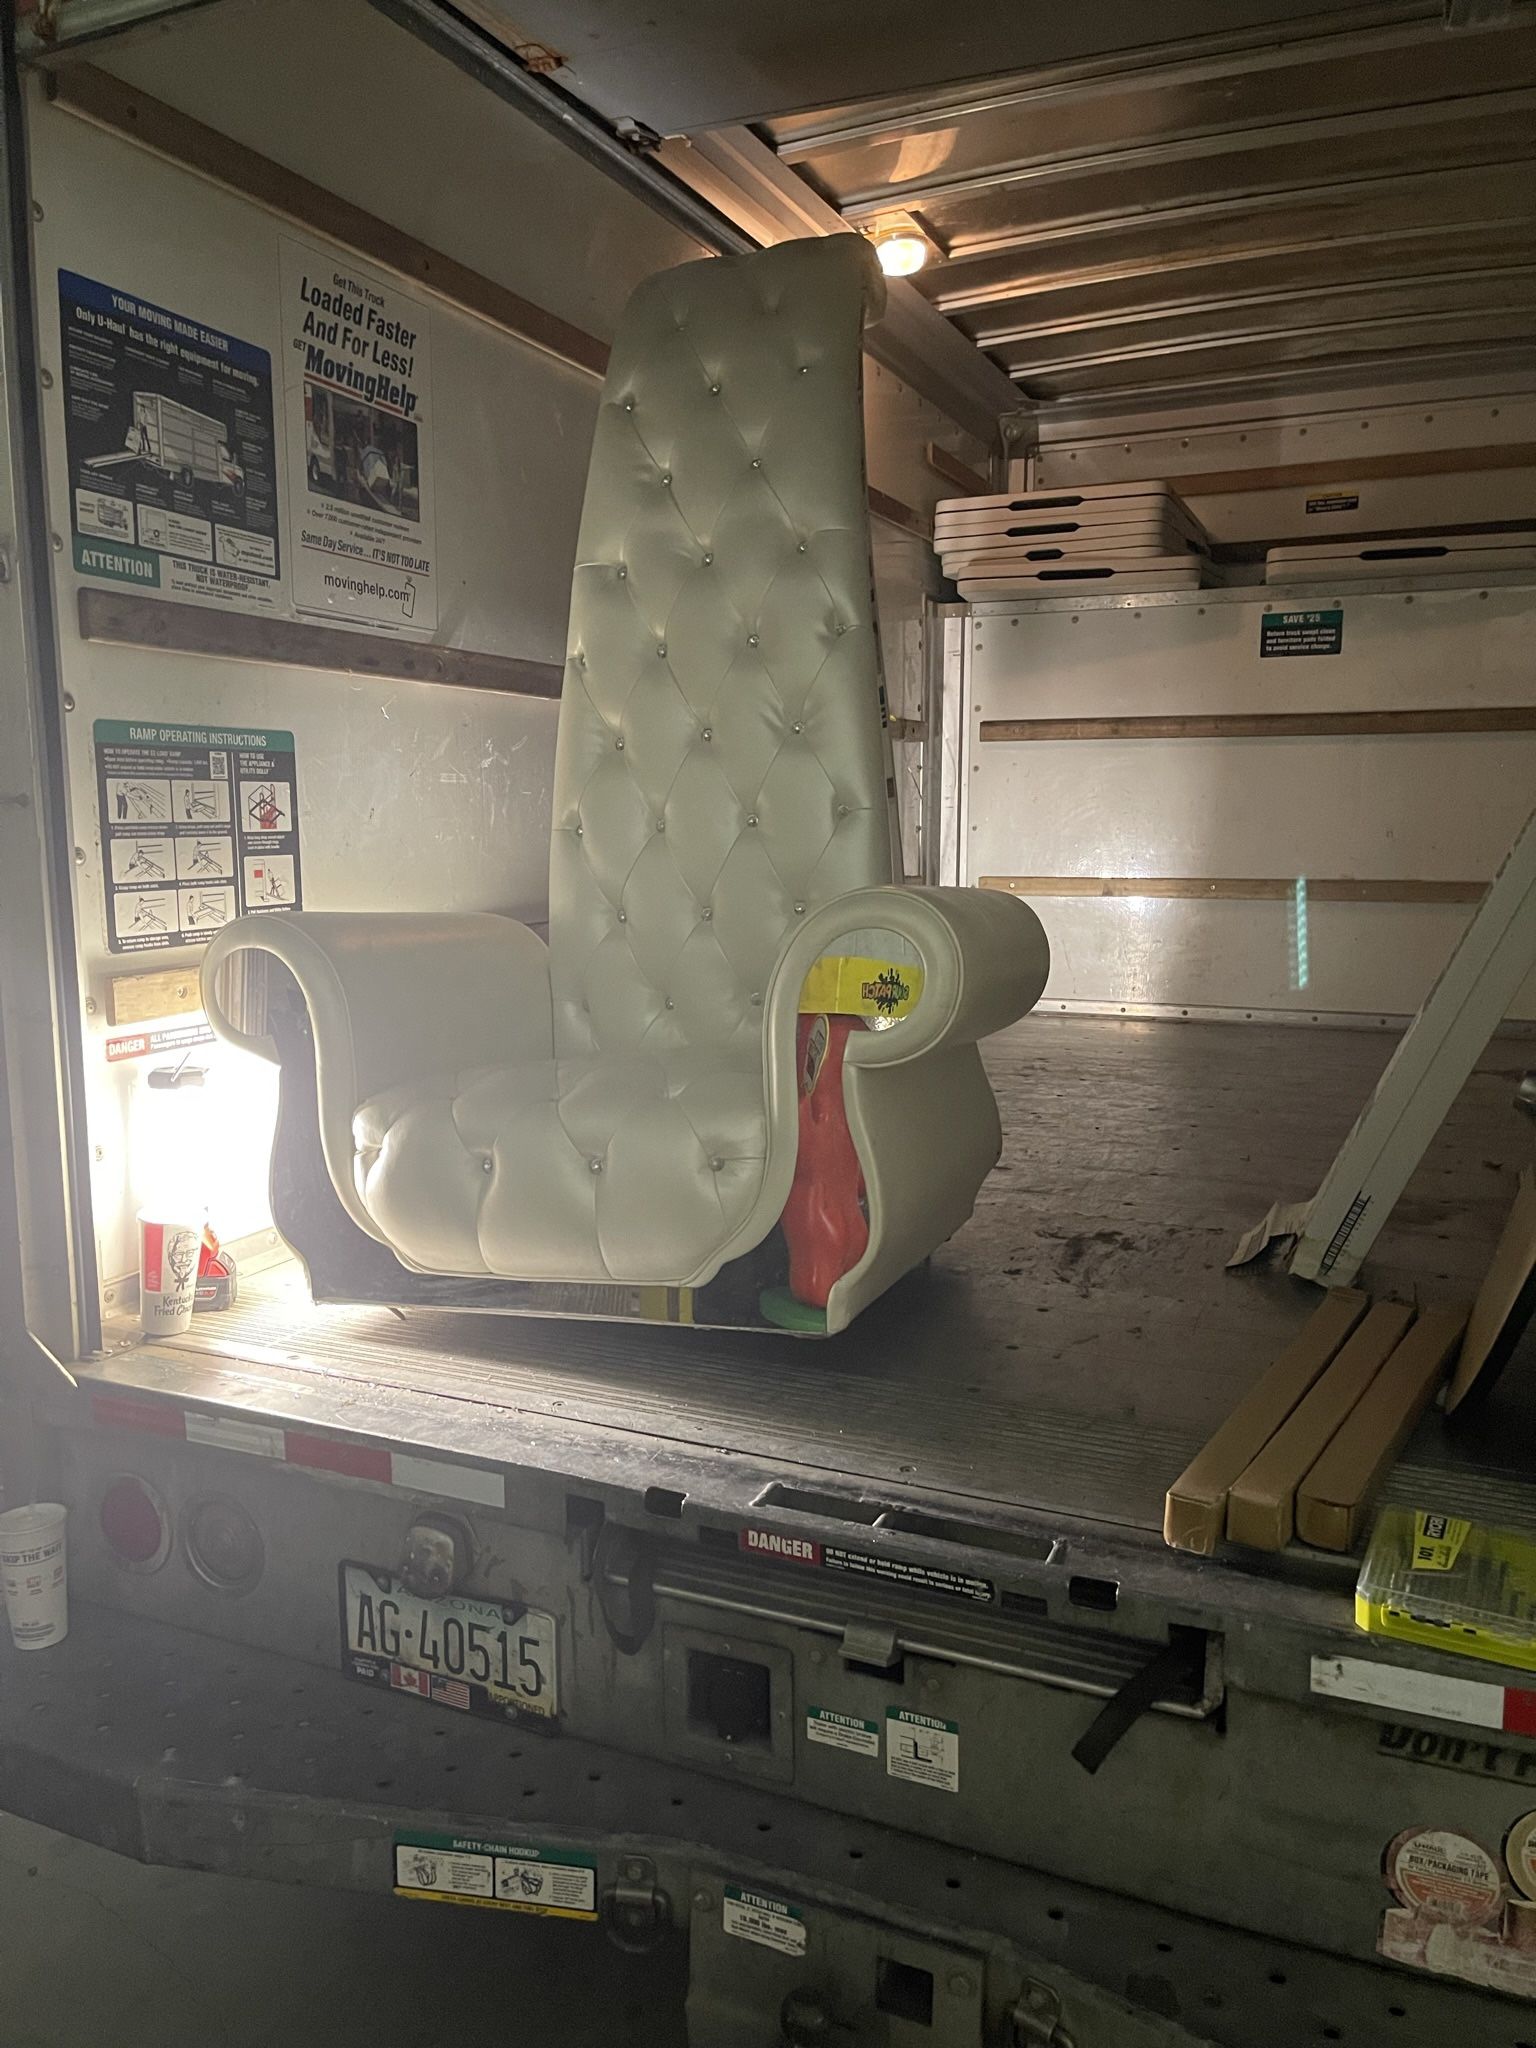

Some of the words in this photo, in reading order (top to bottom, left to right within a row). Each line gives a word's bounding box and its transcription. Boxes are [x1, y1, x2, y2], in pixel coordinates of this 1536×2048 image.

[333, 273, 346, 289] Get
[348, 280, 363, 298] This
[365, 288, 385, 308] Truck
[300, 276, 364, 327] Loaded
[366, 308, 417, 350] Faster
[112, 295, 136, 316] YOUR
[138, 304, 173, 329] MOVING
[174, 319, 199, 341] MADE
[200, 328, 229, 352] EASIER
[76, 307, 95, 327] Only
[129, 327, 144, 343] has
[145, 333, 159, 348] the
[160, 338, 179, 356] right
[180, 348, 220, 370] equipment
[220, 360, 231, 375] for
[293, 338, 307, 352] GET
[302, 311, 339, 346] And
[341, 327, 369, 358] For
[372, 340, 414, 379] Less!
[305, 344, 418, 418] MovingHelp
[301, 530, 322, 546] Same
[322, 535, 337, 552] Day
[372, 548, 386, 562] IT'S
[386, 552, 400, 566] NOT
[401, 556, 414, 569] TOO
[414, 559, 430, 572] LATE
[82, 548, 153, 578] ATTENTION
[172, 560, 187, 571] THIS
[188, 562, 209, 574] TRUCK
[210, 566, 216, 575] IS
[196, 574, 207, 584] NOT
[324, 574, 410, 602] movinghelp.com
[1282, 614, 1304, 624] SAVE
[130, 727, 157, 741] RAMP
[160, 729, 207, 744] OPERATING
[209, 732, 267, 747] INSTRUCTIONS
[108, 1039, 146, 1056] DANGER
[154, 1304, 175, 1316] Fried
[162, 1293, 193, 1307] Kentuck
[22, 1552, 40, 1563] THE
[44, 1542, 63, 1557] WAIT
[748, 1530, 813, 1560] DANGER
[835, 1548, 847, 1559] NOT
[848, 1551, 868, 1563] extend
[869, 1557, 876, 1565] or
[892, 1562, 907, 1574] ramp
[908, 1565, 926, 1576] while
[927, 1569, 949, 1581] vehicle
[950, 1574, 957, 1583] is
[356, 1666, 375, 1678] PAID
[820, 1710, 865, 1730] ATTENTION
[899, 1711, 947, 1730] ATTENTION
[453, 1839, 508, 1857] SAFETY-CHAIN
[508, 1846, 540, 1858] HOOKUP
[1471, 1869, 1489, 1881] TAPE
[741, 1892, 788, 1914] ATTENTION
